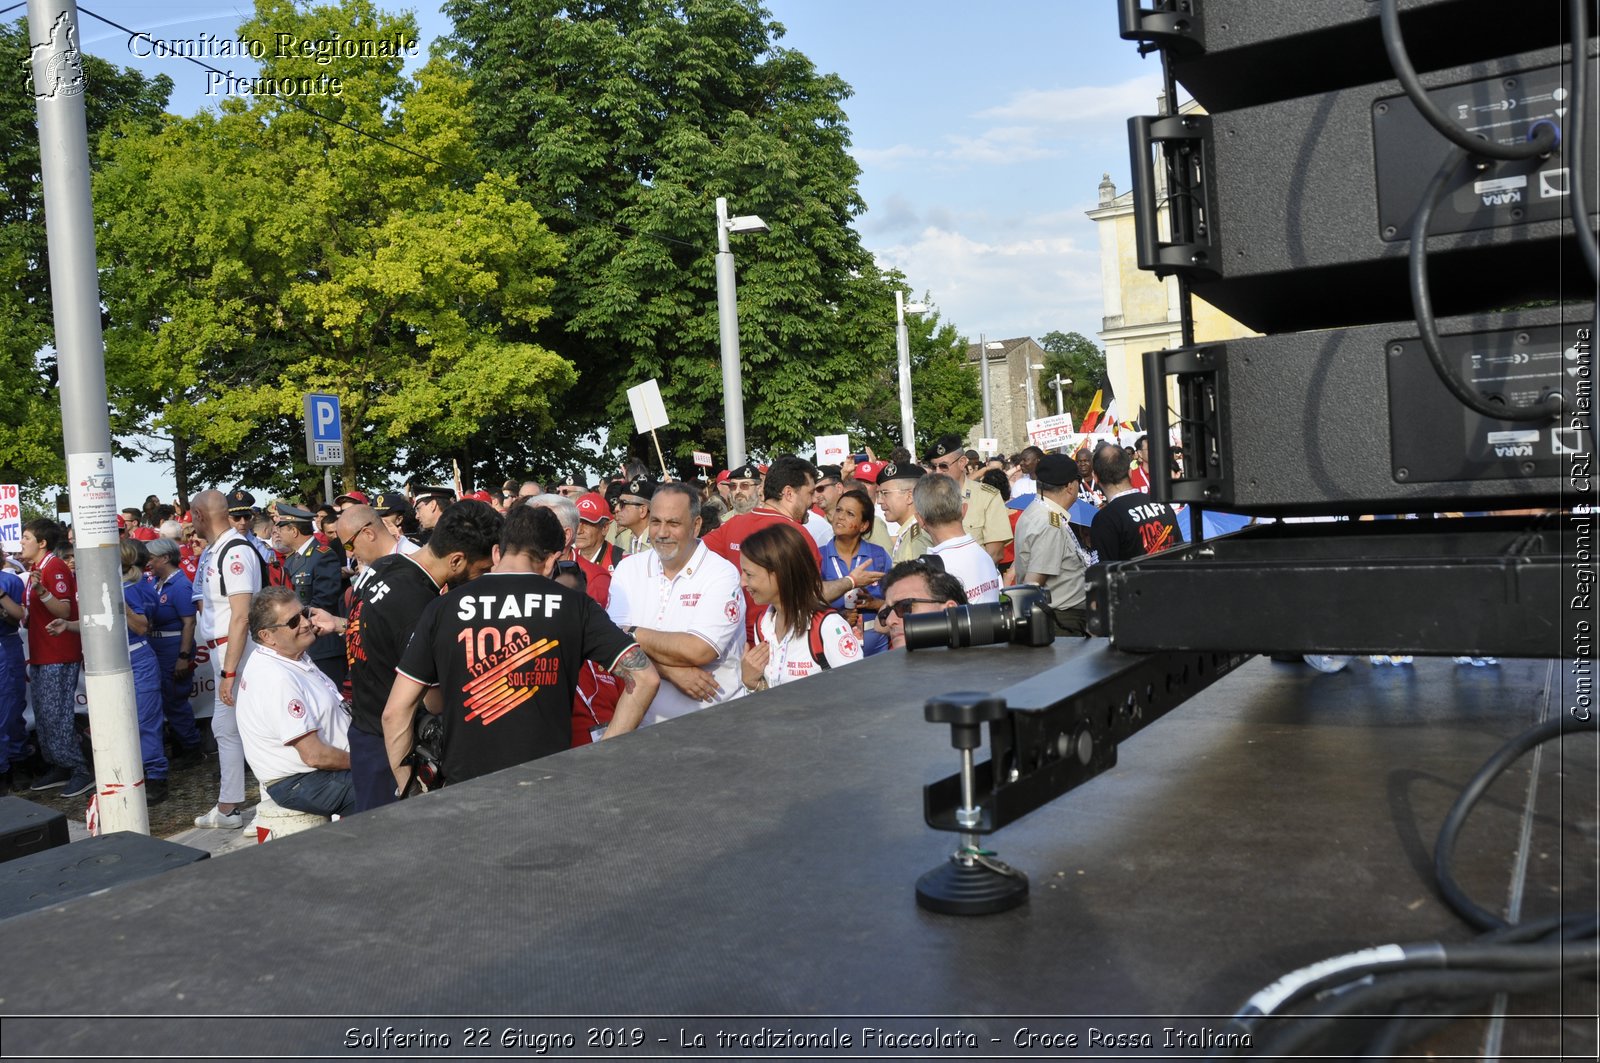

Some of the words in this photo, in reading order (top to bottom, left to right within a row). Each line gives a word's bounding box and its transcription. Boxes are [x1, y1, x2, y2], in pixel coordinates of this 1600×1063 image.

[1482, 191, 1521, 206] KARA
[317, 401, 335, 436] P
[1495, 445, 1533, 457] KARA
[457, 593, 562, 621] STAFF
[469, 634, 531, 678] 1919-2019
[534, 657, 559, 671] 2019
[507, 671, 558, 686] SOLFERINO
